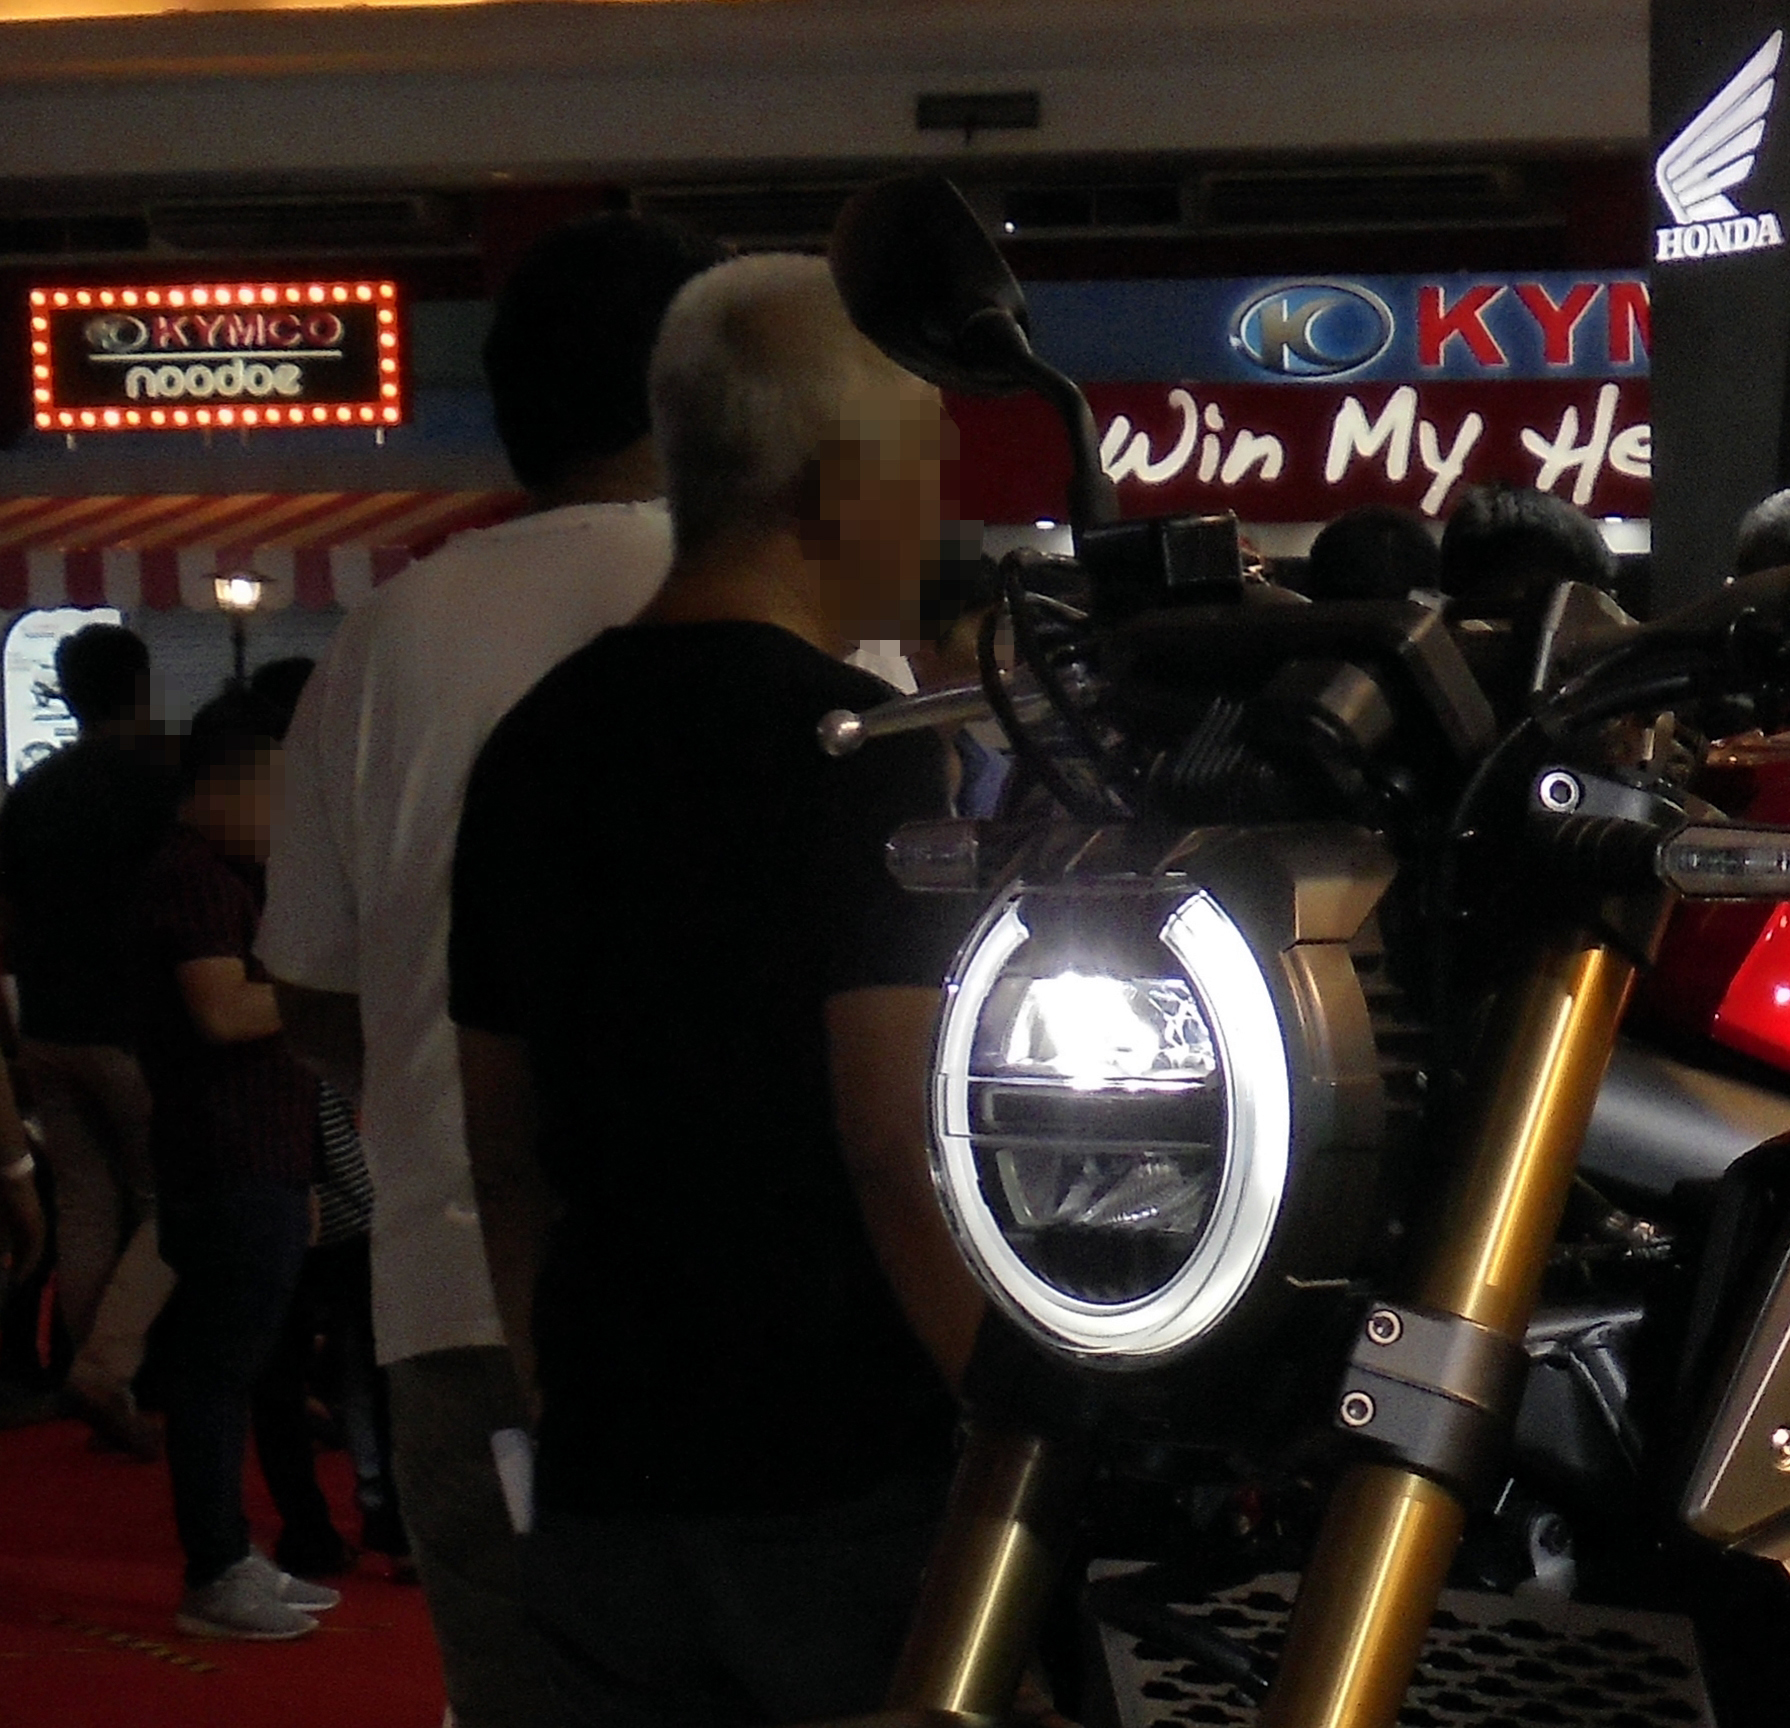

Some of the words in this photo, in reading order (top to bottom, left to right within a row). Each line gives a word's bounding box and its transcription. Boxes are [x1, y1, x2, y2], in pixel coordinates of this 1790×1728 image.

[1655, 212, 1785, 261] HONDA
[153, 311, 344, 348] KYMCO
[125, 358, 302, 399] noodoe
[1100, 388, 1284, 484] Win
[1325, 384, 1484, 516] My
